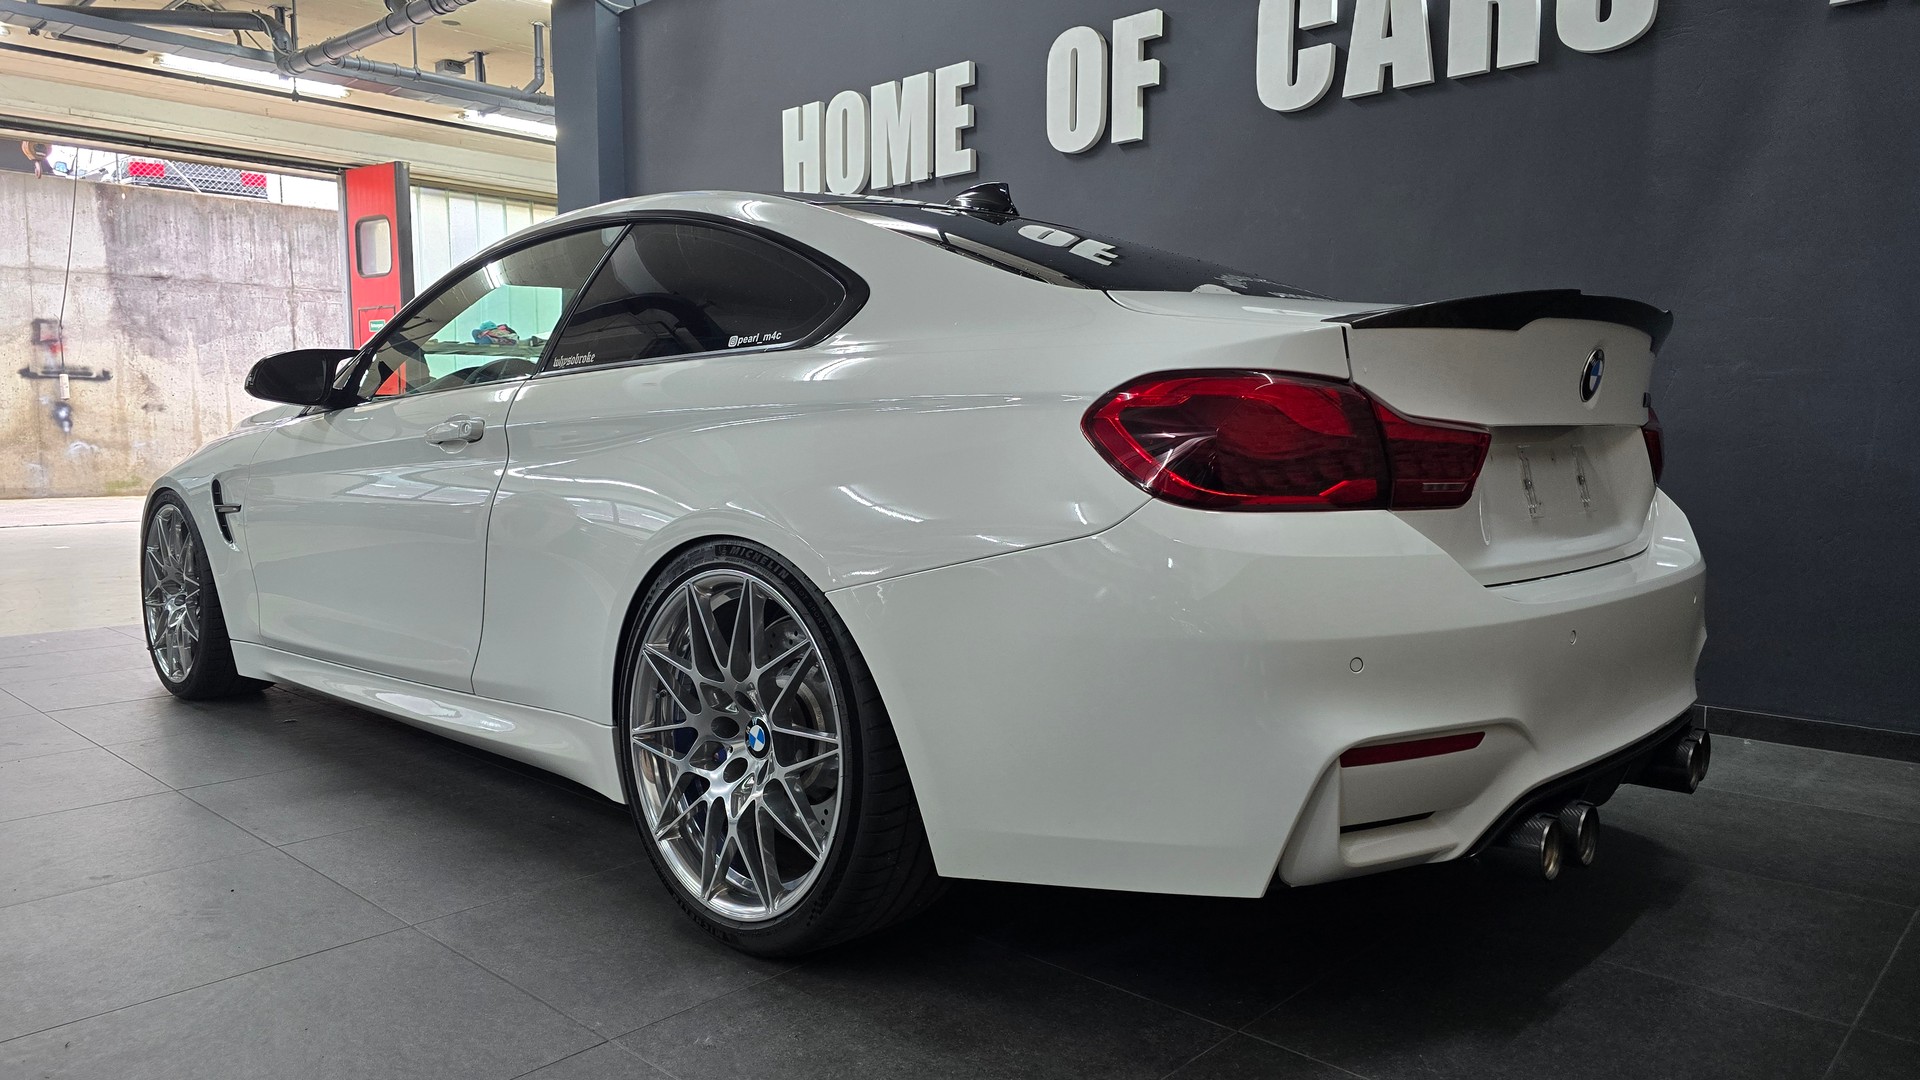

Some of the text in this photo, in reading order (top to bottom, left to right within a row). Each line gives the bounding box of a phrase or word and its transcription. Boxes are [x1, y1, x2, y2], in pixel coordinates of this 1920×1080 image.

[782, 60, 976, 195] HOME
[1046, 8, 1163, 154] OF
[729, 546, 789, 580] MICHELIN
